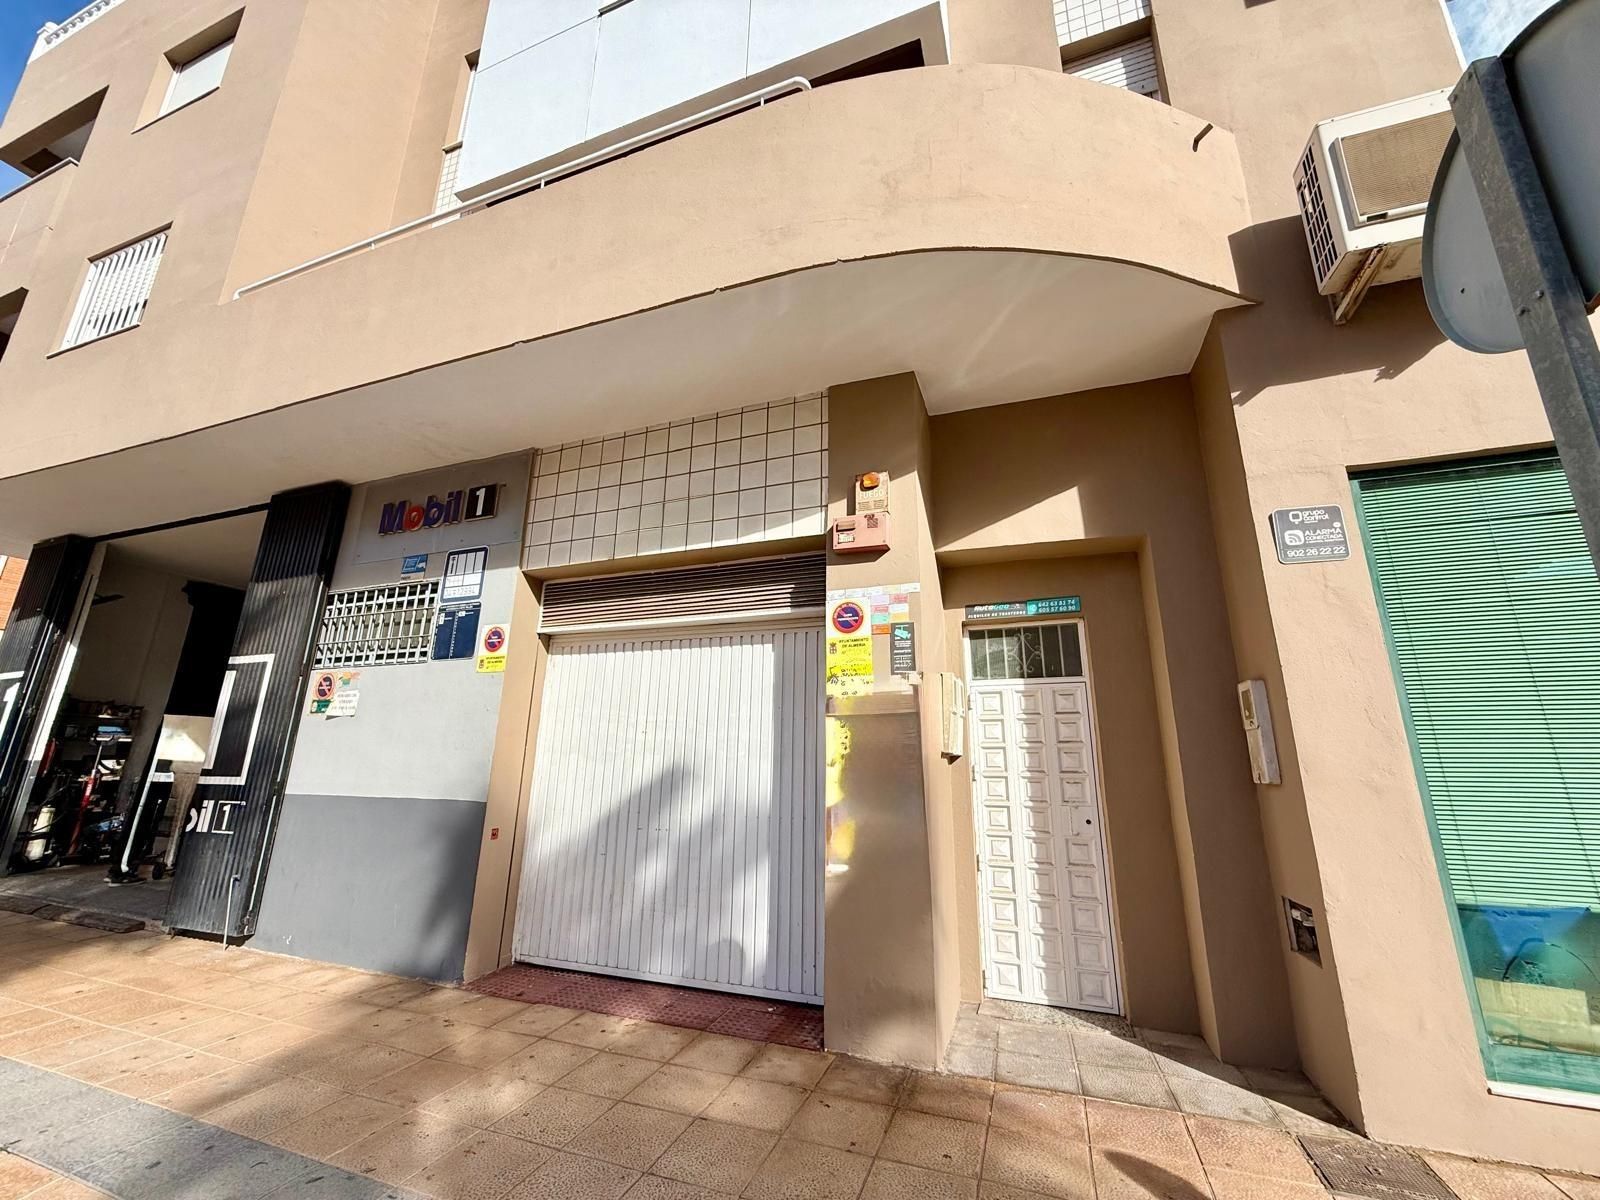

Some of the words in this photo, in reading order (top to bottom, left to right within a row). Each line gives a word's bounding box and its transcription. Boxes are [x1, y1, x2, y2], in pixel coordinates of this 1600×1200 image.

[859, 488, 884, 499] FUEGO
[378, 490, 465, 536] Mobil
[1302, 509, 1325, 517] grupo
[1303, 513, 1329, 521] control
[1304, 528, 1342, 536] ALARMA
[1287, 549, 1305, 557] 902
[1306, 548, 1318, 556] 26
[1320, 547, 1332, 555] 22
[1333, 546, 1346, 554] 22
